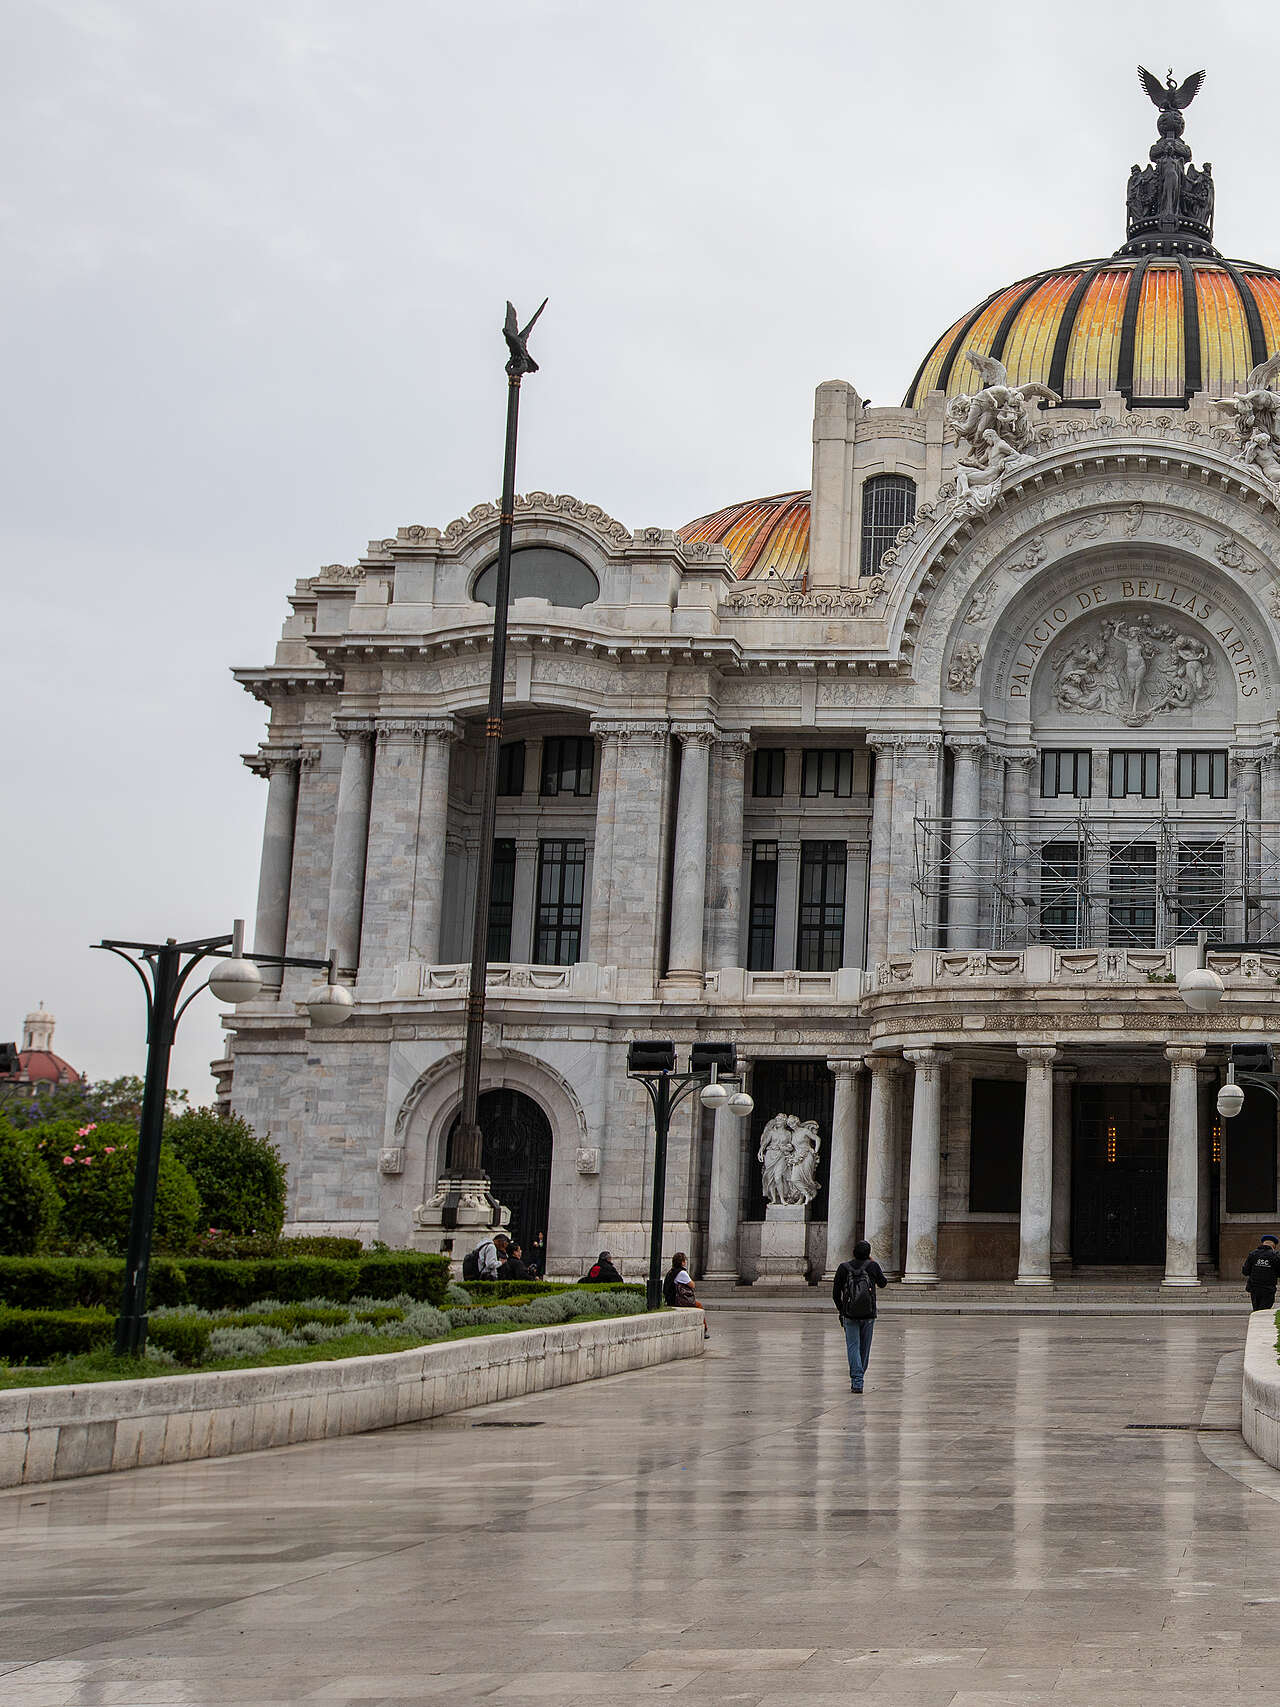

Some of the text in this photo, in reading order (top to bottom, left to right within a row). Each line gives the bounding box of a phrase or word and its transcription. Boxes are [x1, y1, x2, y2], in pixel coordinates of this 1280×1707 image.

[1010, 581, 1258, 698] PALACIO DE BELLAS ARTES
